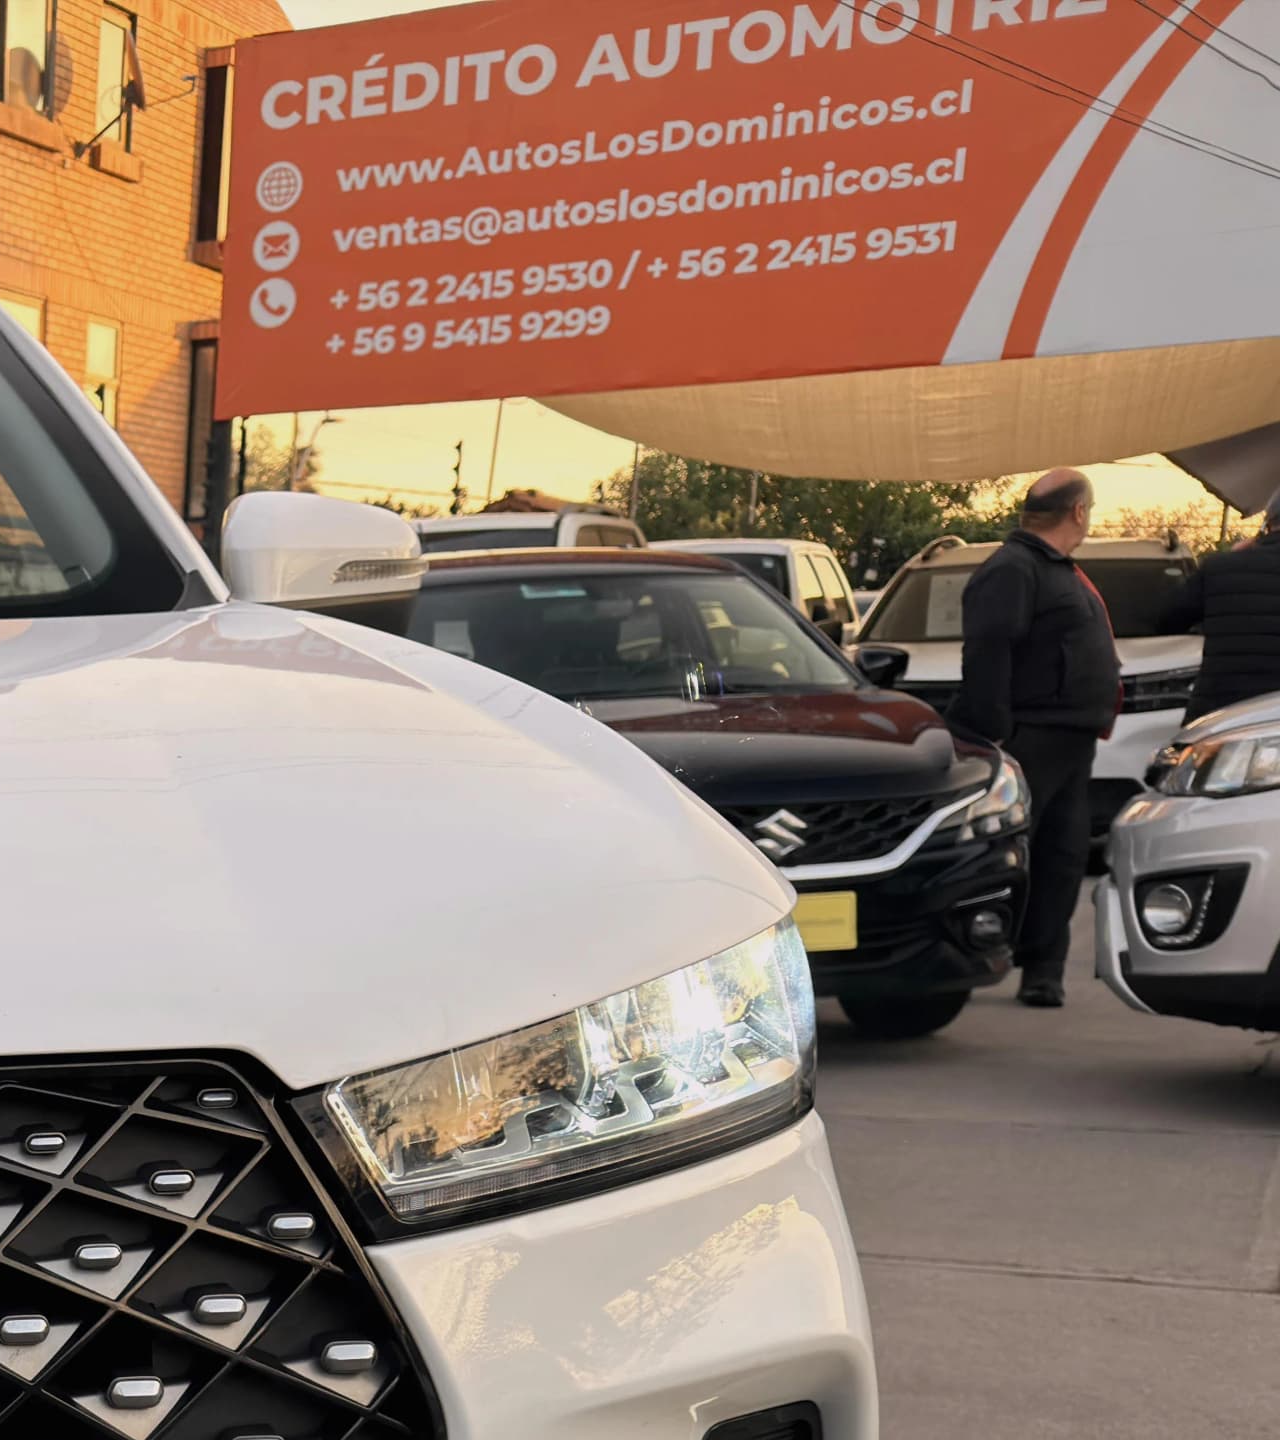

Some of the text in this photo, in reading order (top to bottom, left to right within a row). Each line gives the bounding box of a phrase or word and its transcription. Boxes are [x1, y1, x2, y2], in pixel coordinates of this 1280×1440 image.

[260, 0, 1108, 131] CRÉDITO AUTOMOTR
[336, 80, 973, 192] www.AutosLosDominicos.cl
[332, 148, 966, 253] ventas@autoslosdominicos.cl
[330, 220, 958, 311] + 56 2 2415 9530 / + 56 2 2415 9531
[325, 304, 610, 356] + 56 9 5415 9299
